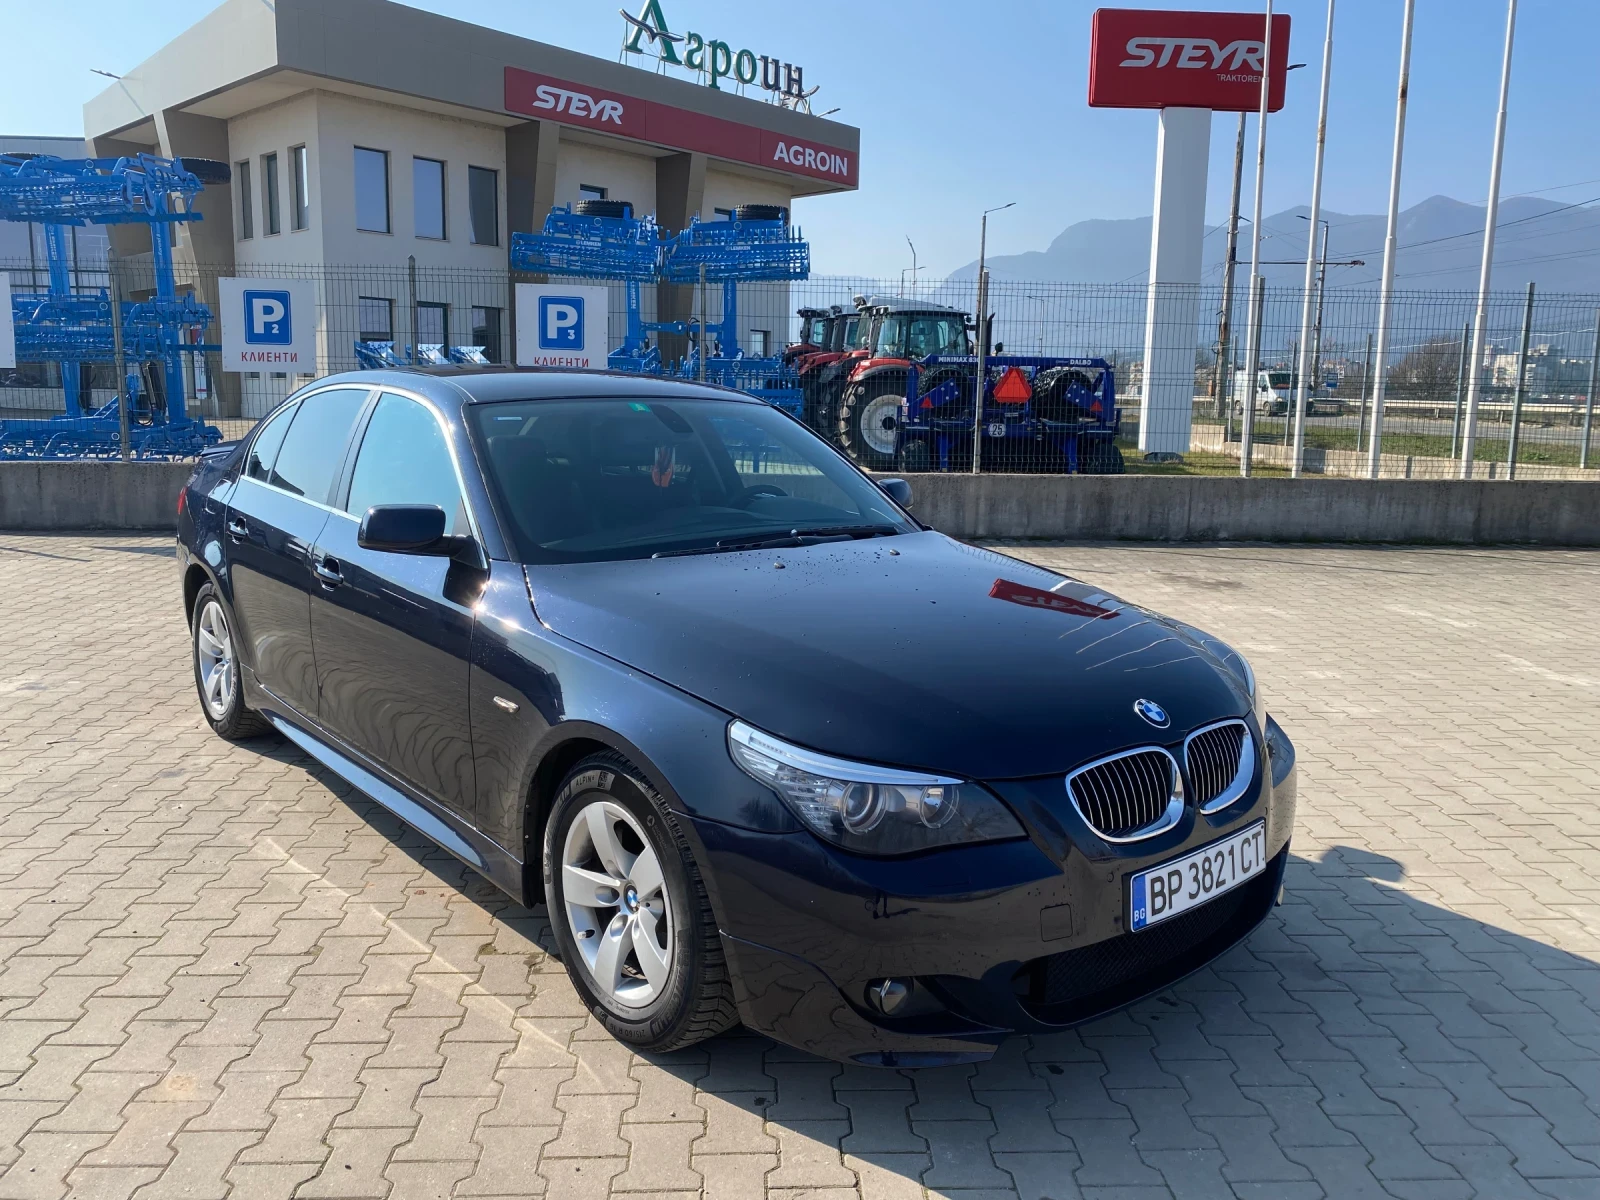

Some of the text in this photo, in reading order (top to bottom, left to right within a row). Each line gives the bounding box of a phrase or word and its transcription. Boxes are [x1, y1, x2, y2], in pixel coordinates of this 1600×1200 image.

[1119, 36, 1266, 72] STEYR
[532, 84, 624, 125] STEYR
[773, 141, 848, 176] AGROIN
[241, 351, 298, 363] КЛИЕНТИ
[534, 356, 590, 368] КЛИЕНТИ
[992, 424, 1003, 436] 25
[1188, 844, 1237, 900] 3821
[1134, 908, 1146, 922] BG
